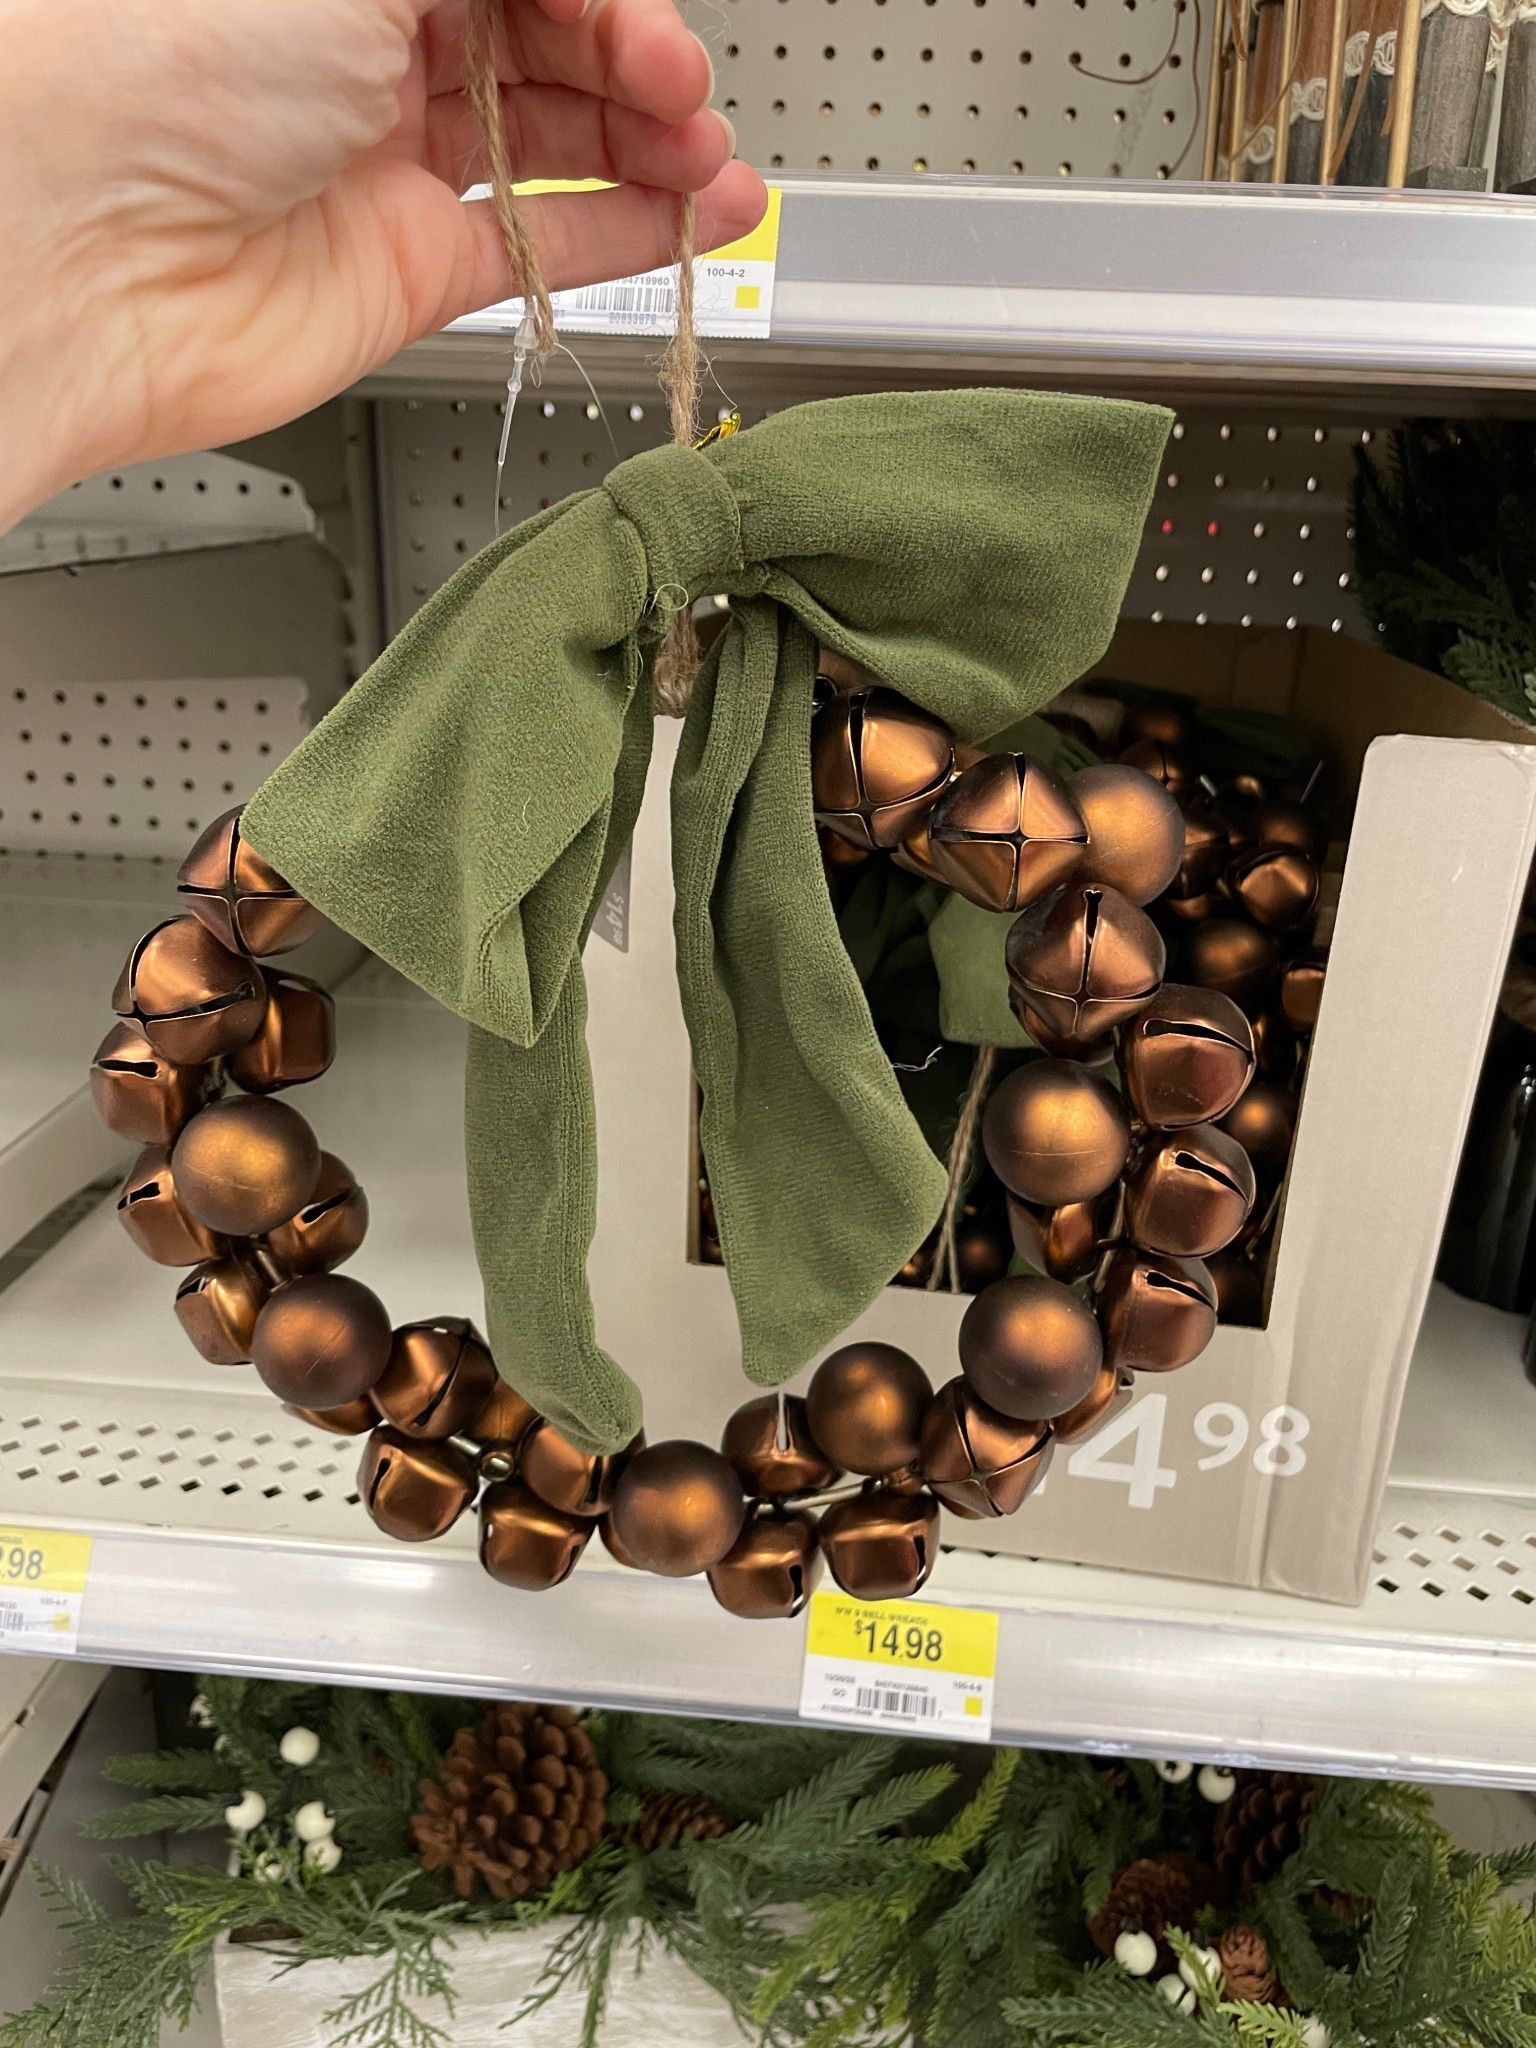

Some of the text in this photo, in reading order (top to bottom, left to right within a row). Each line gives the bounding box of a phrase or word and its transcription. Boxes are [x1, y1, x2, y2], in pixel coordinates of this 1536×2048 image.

[706, 268, 745, 278] 100-4-2
[0, 1545, 44, 1580] .98
[854, 1619, 943, 1662] $14.98
